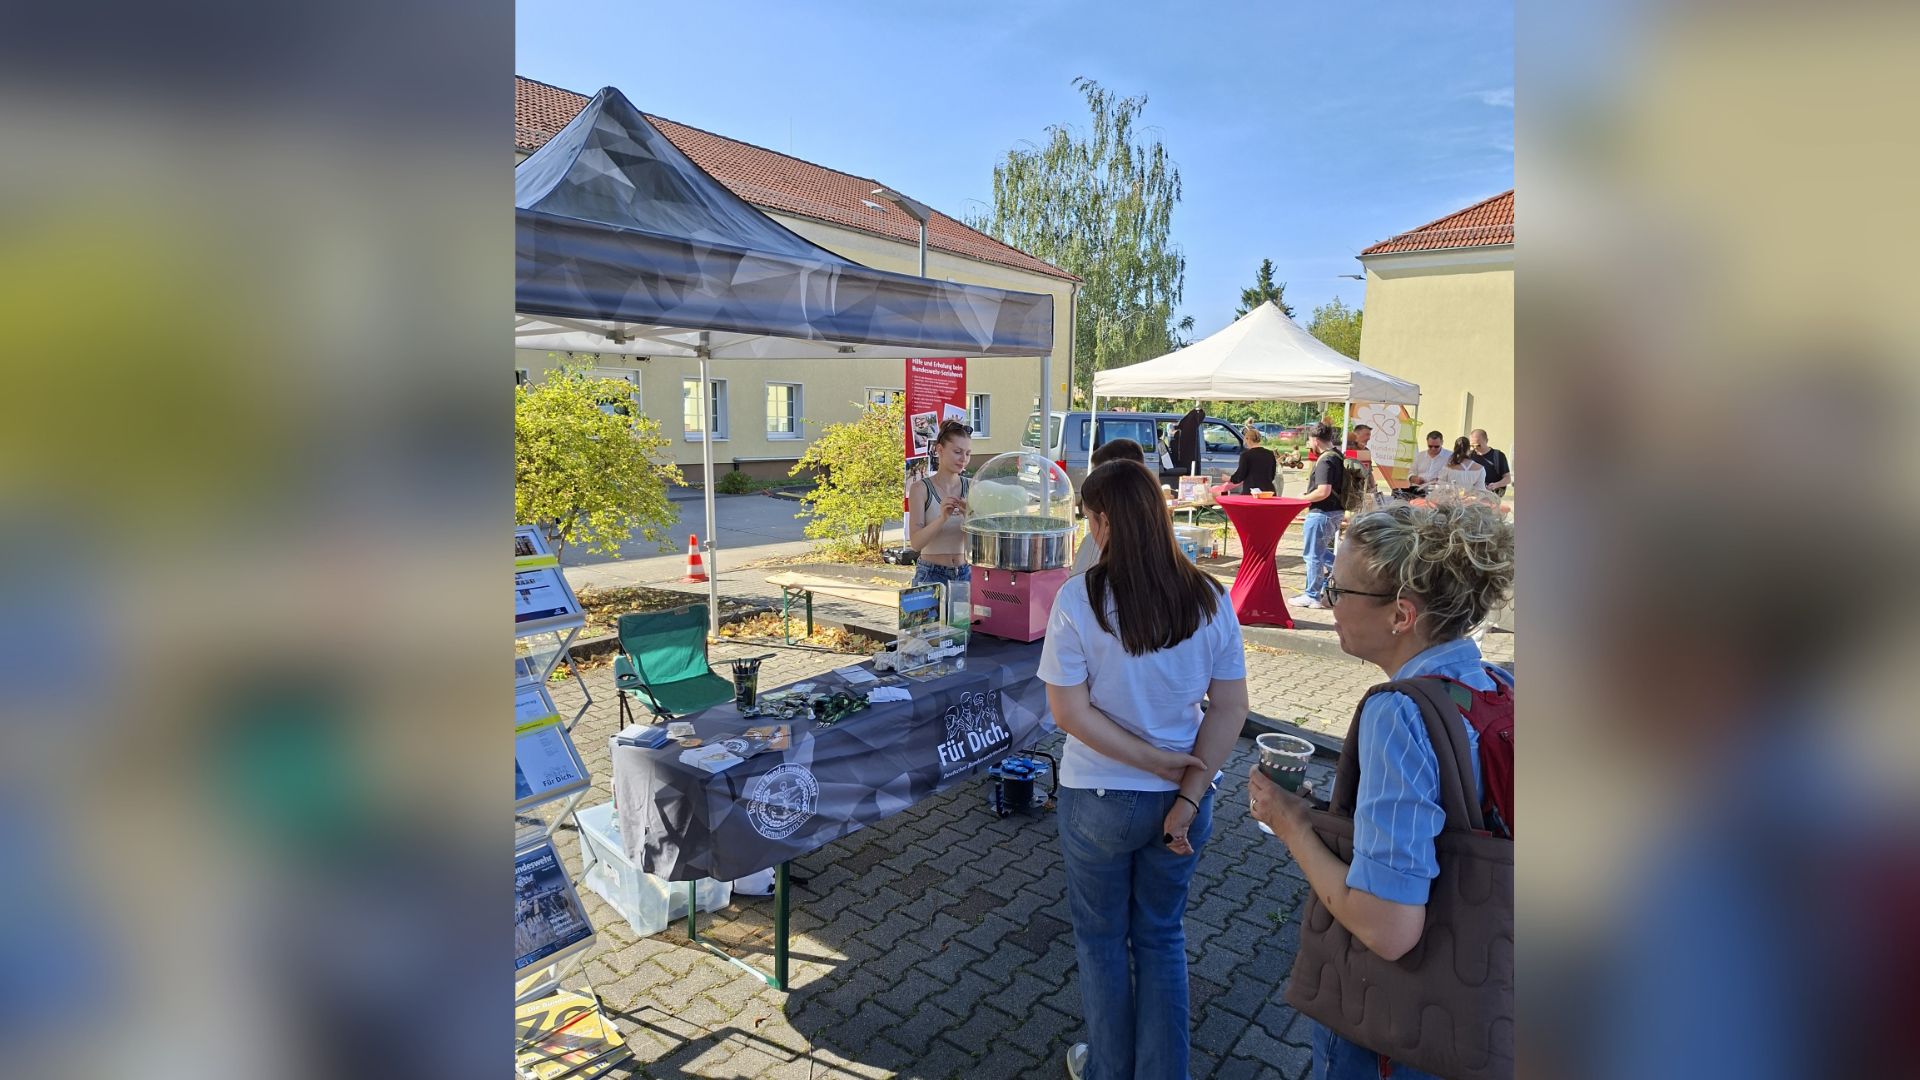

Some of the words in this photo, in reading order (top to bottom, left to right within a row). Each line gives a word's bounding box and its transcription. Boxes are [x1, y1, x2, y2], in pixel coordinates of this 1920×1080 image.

[938, 740, 966, 766] Für
[967, 722, 1010, 752] Dich.
[542, 778, 556, 787] Für
[556, 772, 574, 783] Dich.
